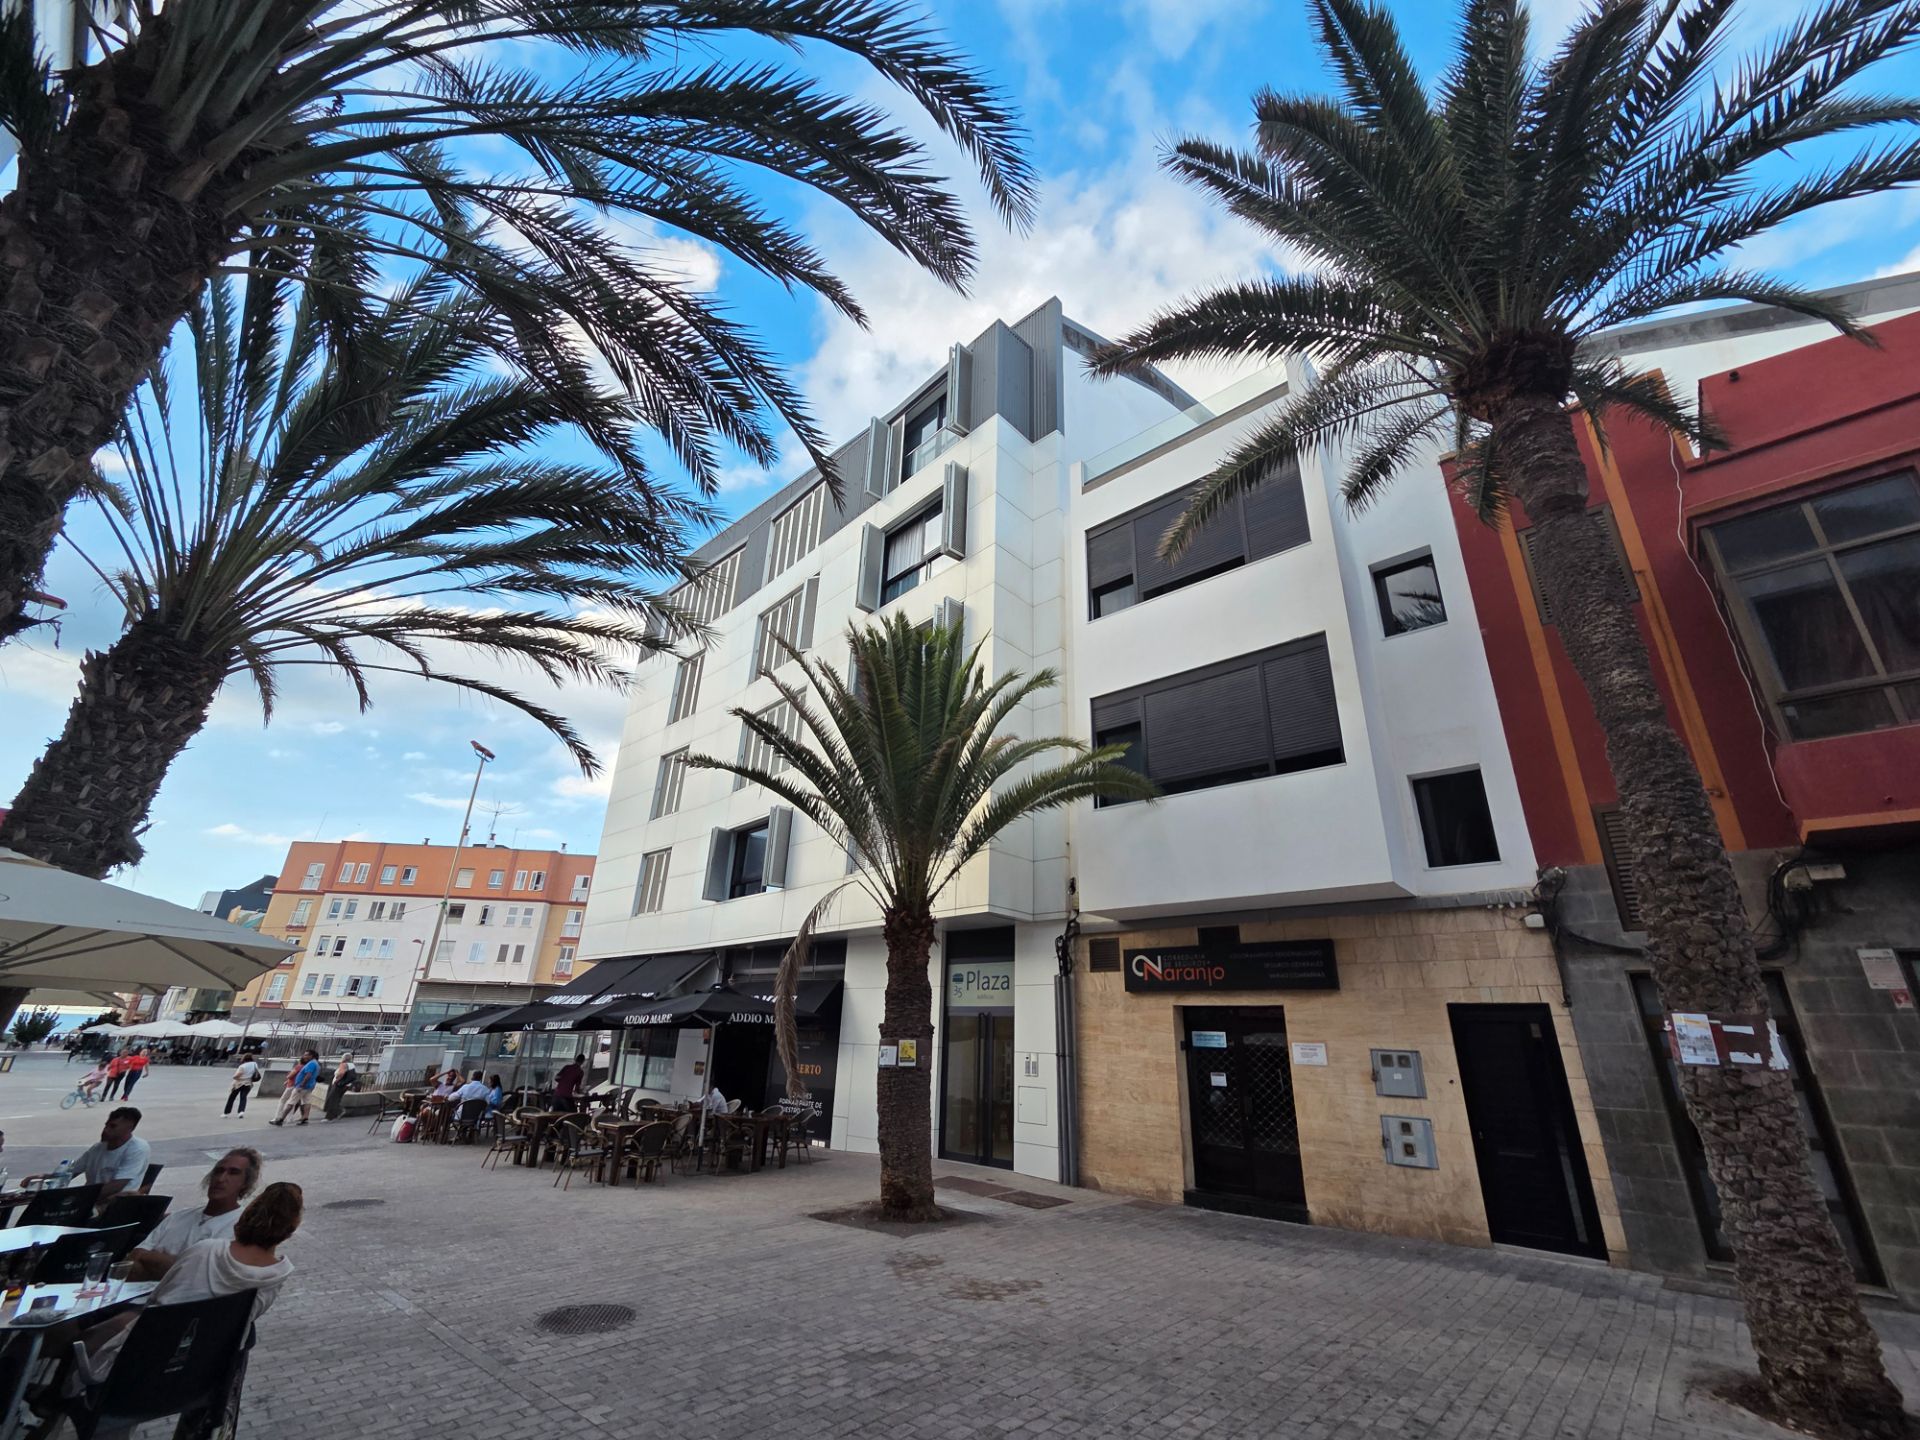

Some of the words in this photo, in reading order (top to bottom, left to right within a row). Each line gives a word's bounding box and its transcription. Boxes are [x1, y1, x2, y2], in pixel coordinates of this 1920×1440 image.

[966, 970, 1010, 991] Plaza
[1143, 960, 1225, 987] Naranjo
[623, 1015, 649, 1024] ADDIO
[649, 1013, 673, 1024] MARE
[729, 1012, 762, 1024] ADDIO
